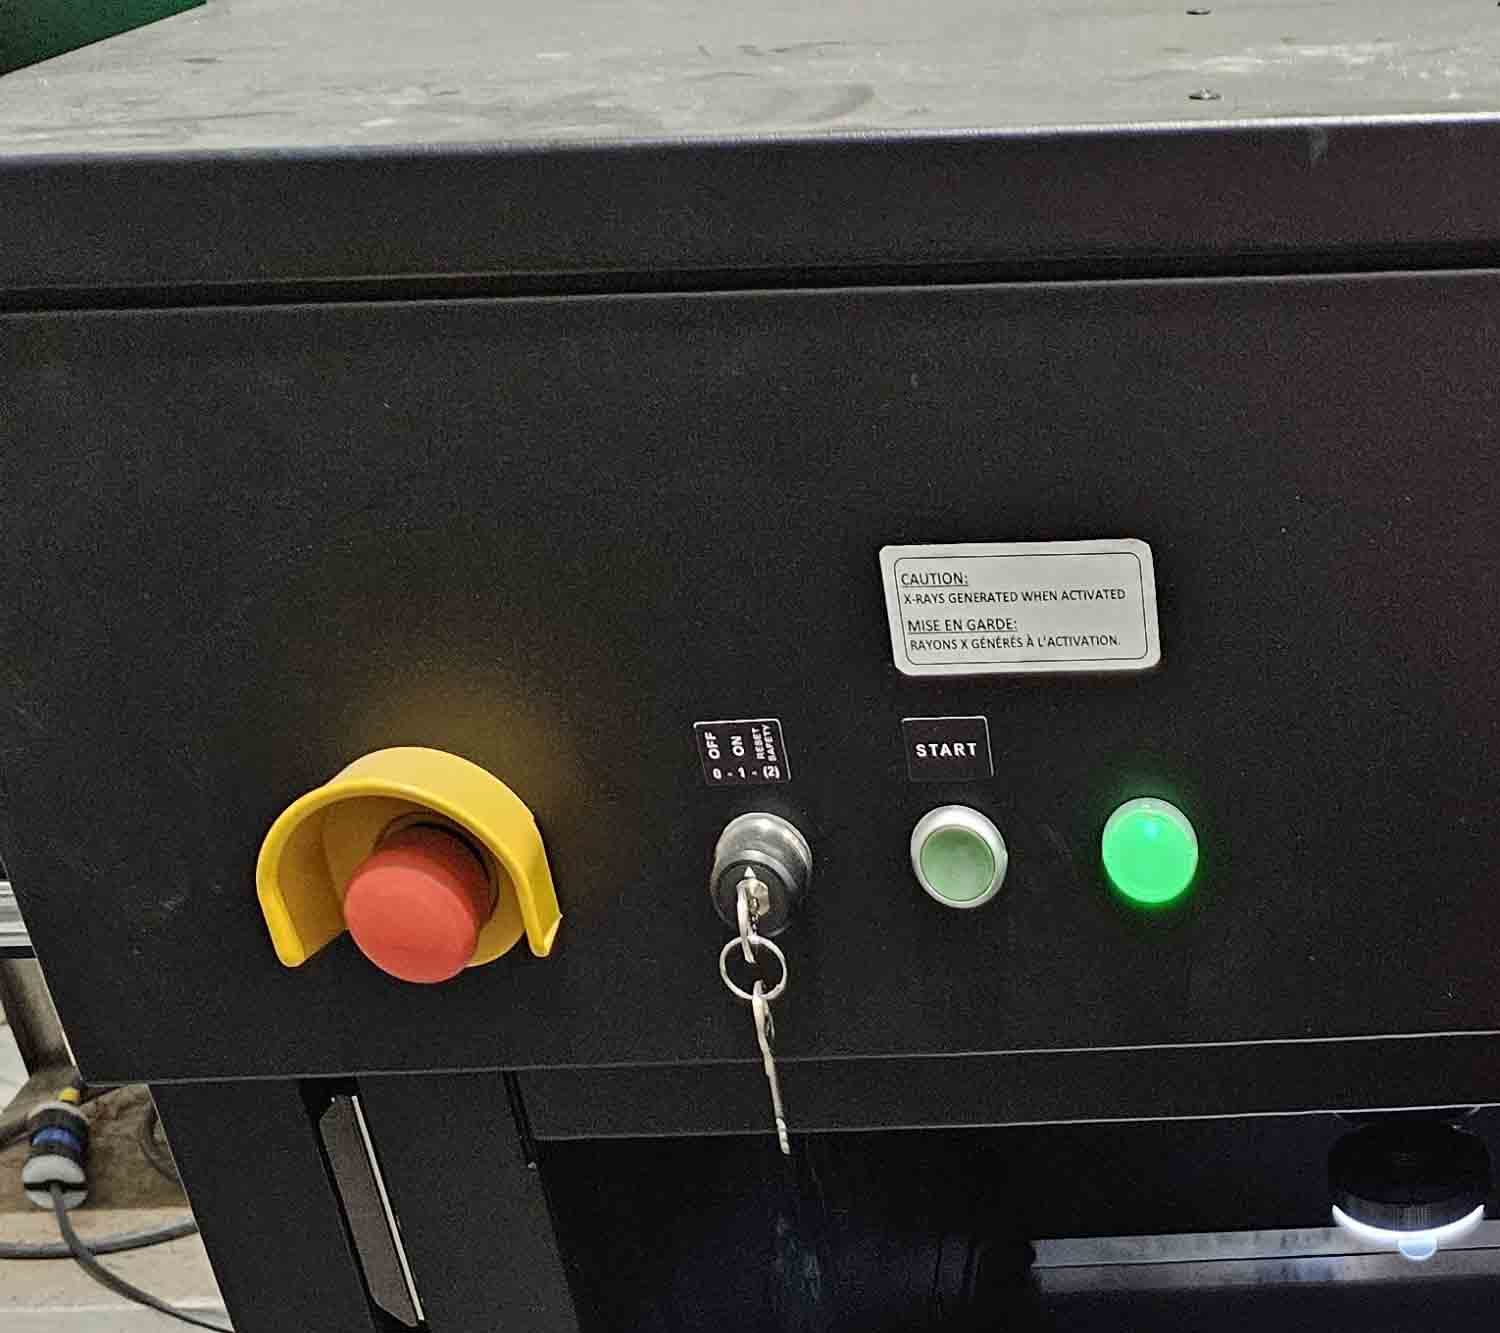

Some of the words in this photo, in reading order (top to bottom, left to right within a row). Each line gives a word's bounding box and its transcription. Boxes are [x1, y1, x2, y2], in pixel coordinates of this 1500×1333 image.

[901, 572, 968, 586] CAUTION:
[904, 593, 945, 605] X-RAYS
[949, 591, 1017, 604] GENERATED
[1021, 590, 1058, 602] WHEN
[1061, 588, 1125, 601] ACTIVATED
[907, 619, 941, 632] MISE
[945, 618, 962, 631] EN
[966, 617, 1017, 631] GARDE:
[910, 638, 958, 650] RAYONS
[961, 638, 969, 649] X
[971, 635, 1023, 649] GÉNÉRÉS
[1026, 634, 1034, 647] À
[1038, 634, 1120, 648] L'ACTIVATION.
[704, 731, 720, 759] OFF
[731, 736, 744, 756] ON
[752, 727, 765, 759] RESET
[761, 724, 777, 762] SAFETY
[915, 742, 976, 757] START
